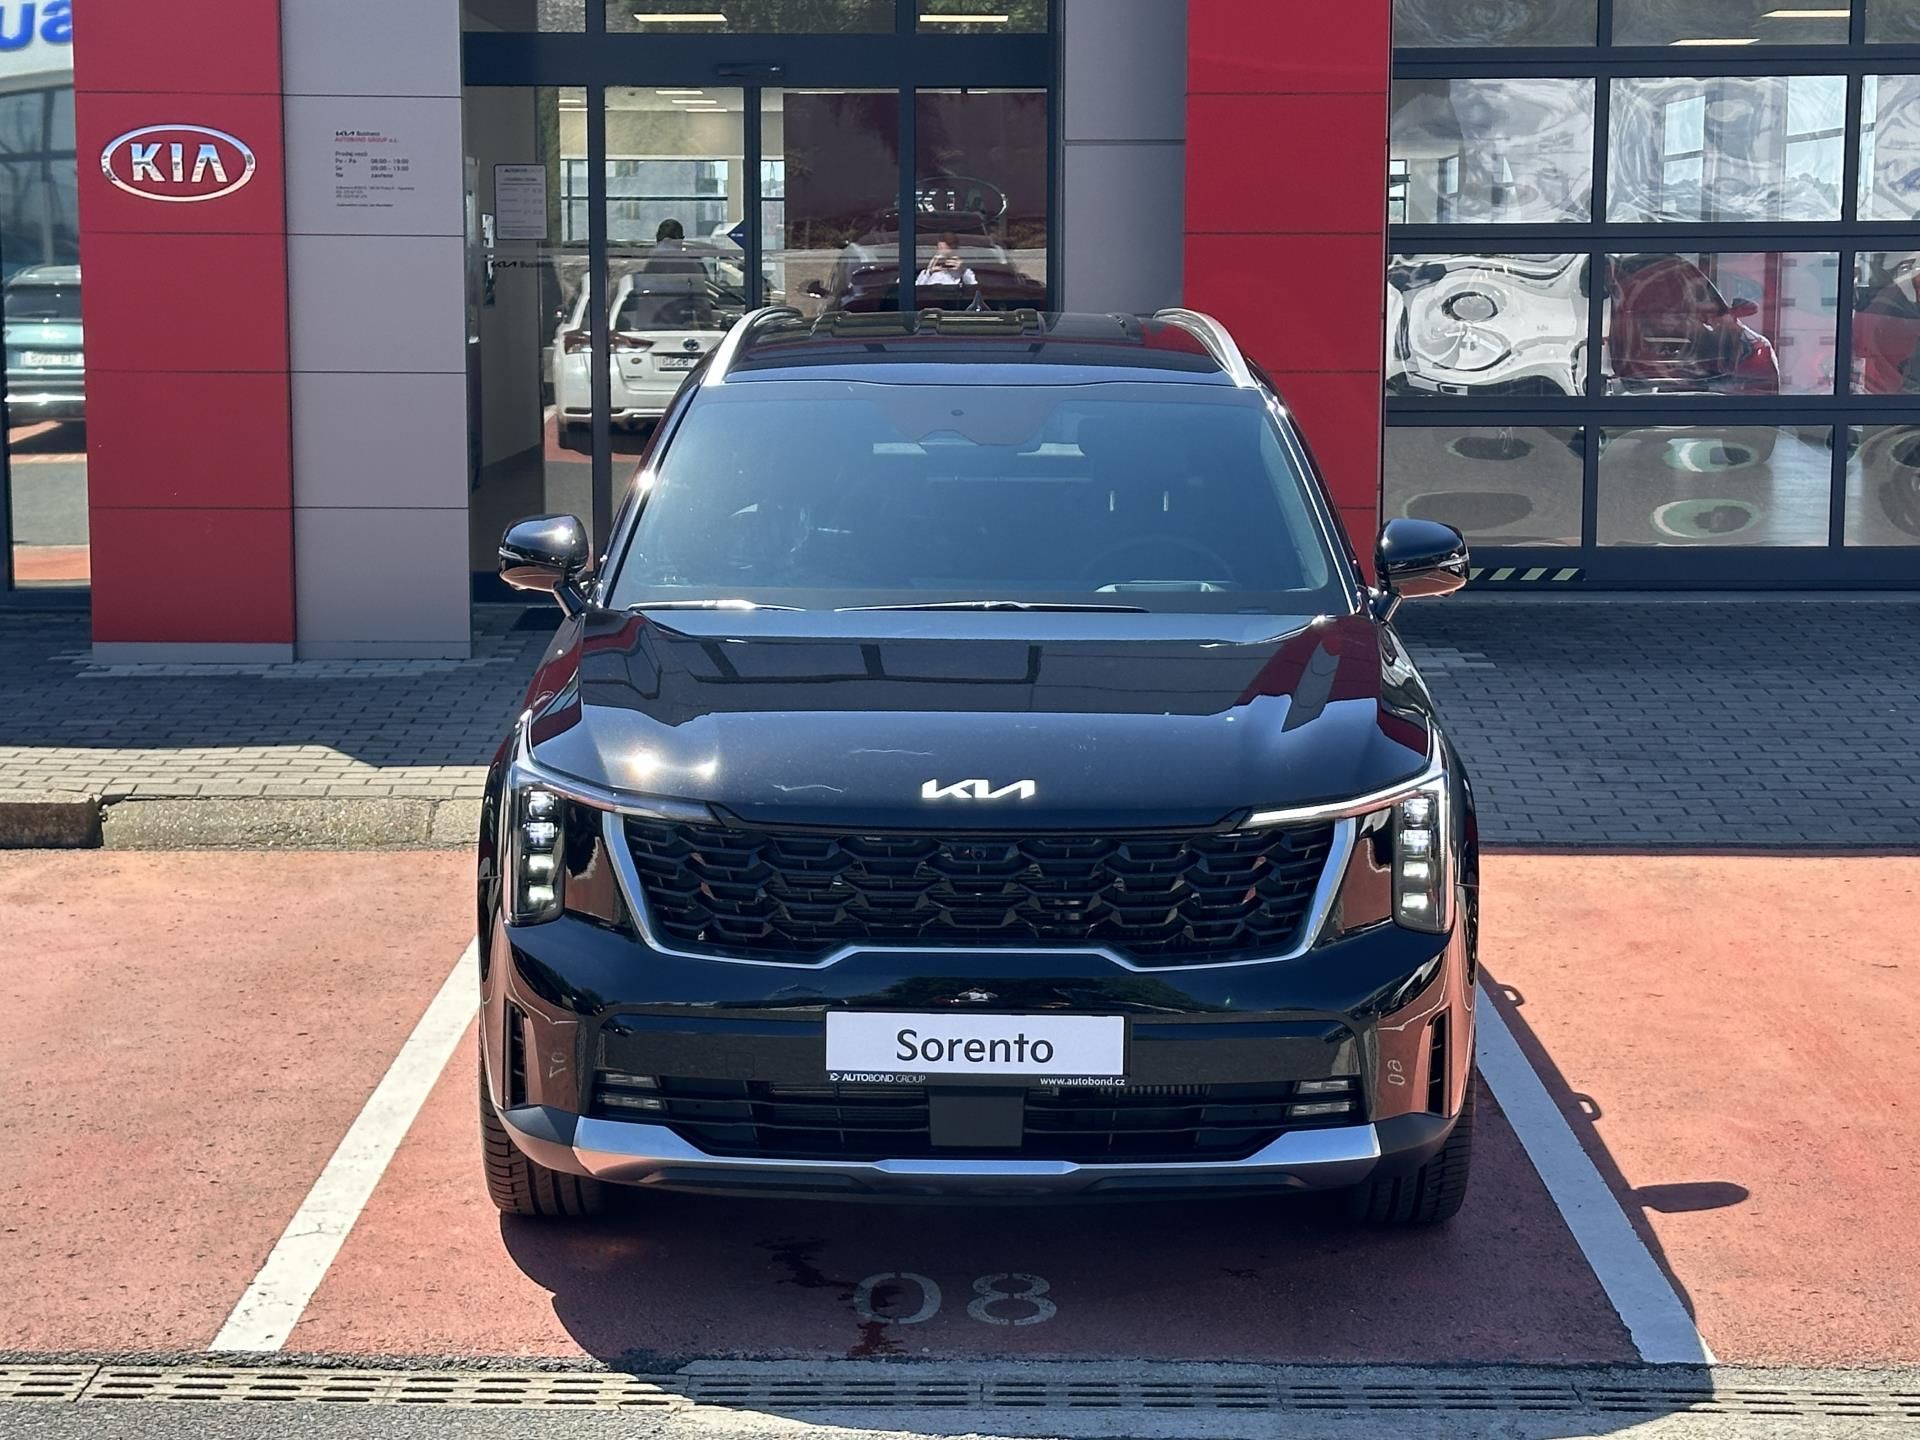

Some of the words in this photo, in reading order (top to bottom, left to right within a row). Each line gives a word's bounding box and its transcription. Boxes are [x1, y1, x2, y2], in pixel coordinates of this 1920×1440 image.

[130, 143, 228, 183] KIA
[921, 778, 1036, 800] KIA
[896, 1028, 1054, 1064] Sorento
[842, 1073, 894, 1083] AUTOBOND
[895, 1074, 927, 1084] GROUP
[1039, 1077, 1126, 1086] www.autobond.cz
